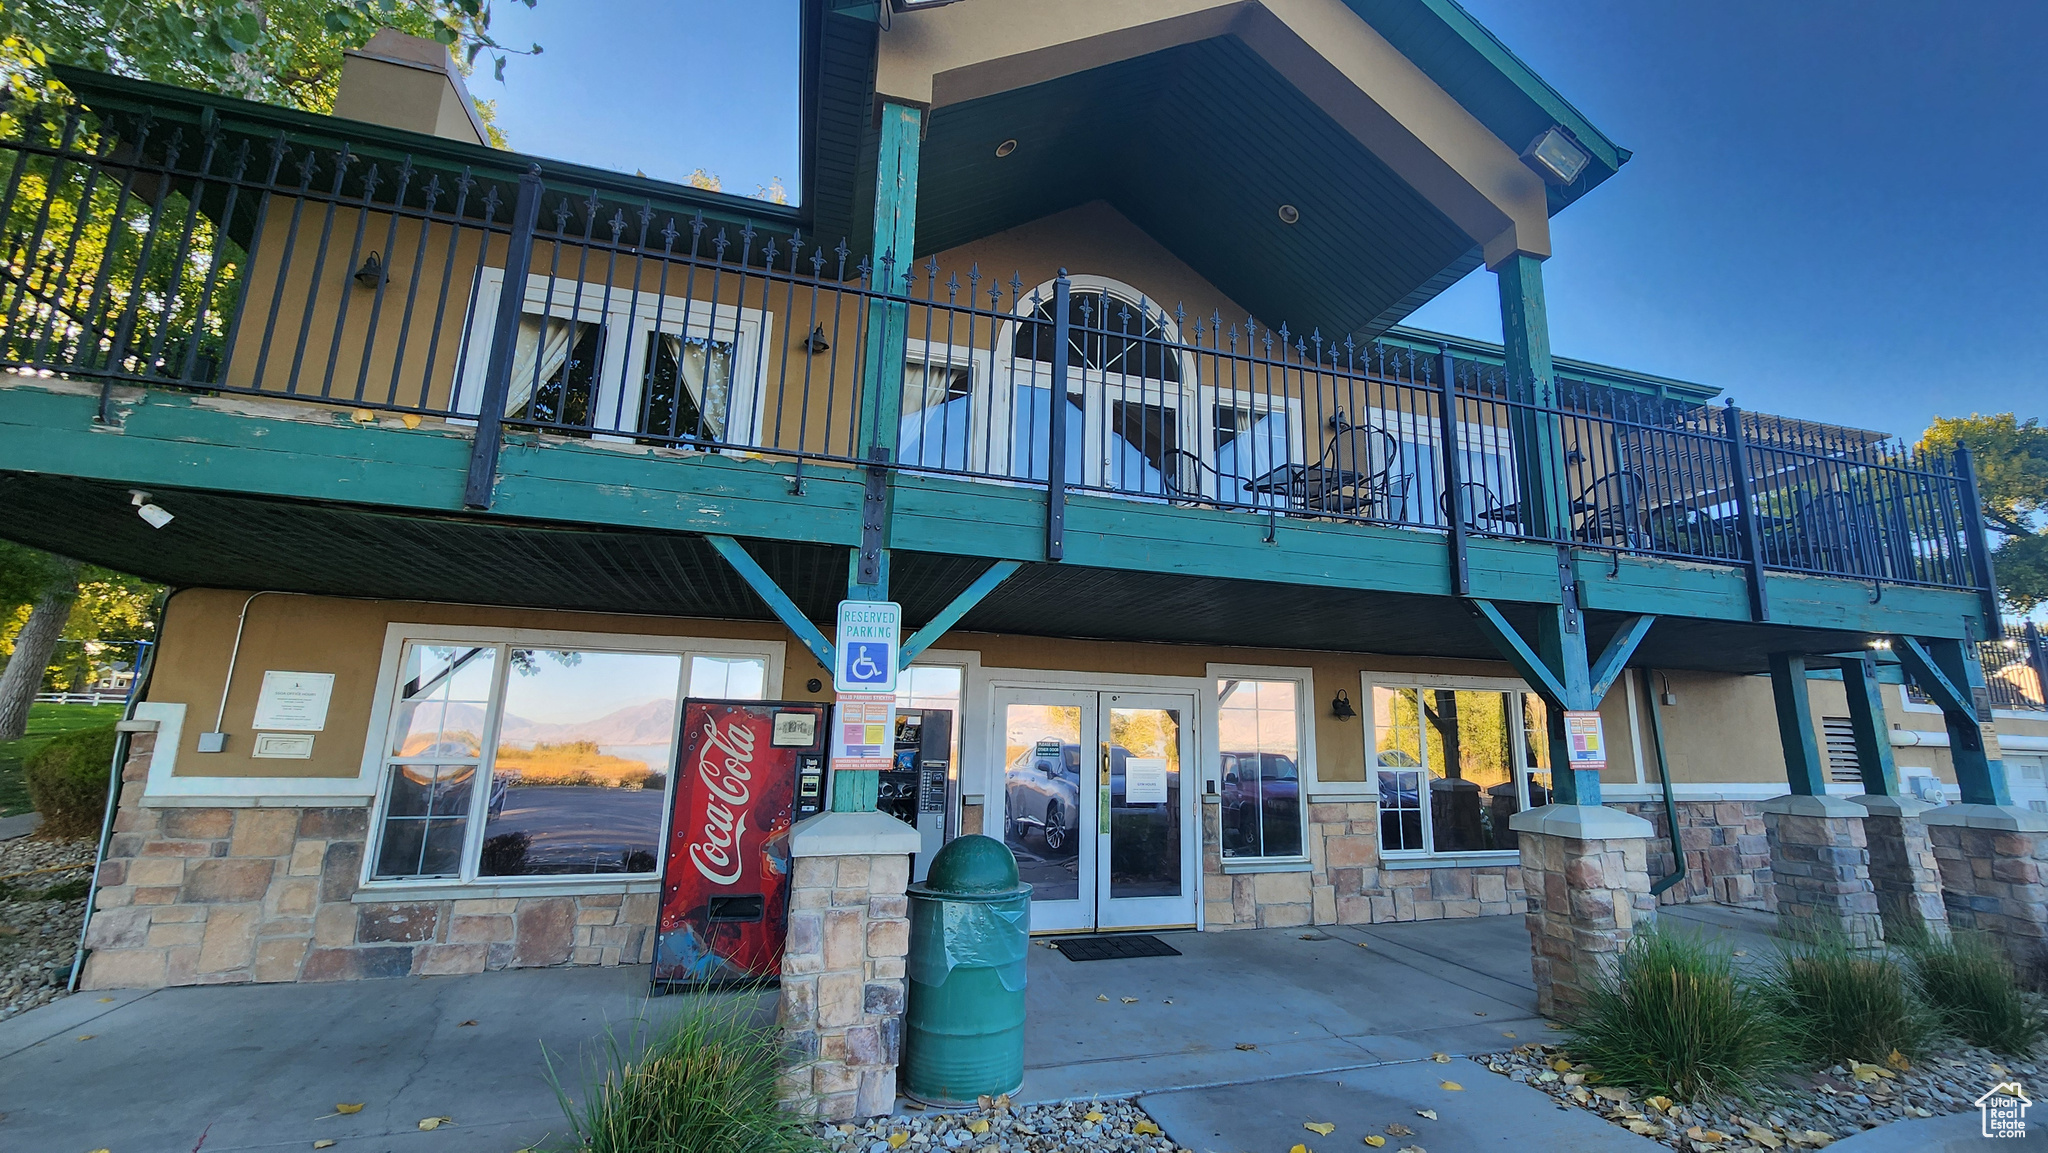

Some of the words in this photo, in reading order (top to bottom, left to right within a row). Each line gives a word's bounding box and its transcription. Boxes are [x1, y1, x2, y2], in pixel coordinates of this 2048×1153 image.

[844, 610, 895, 624] RESERVED
[846, 625, 891, 638] PARKING
[689, 712, 755, 886] Coca-Cola
